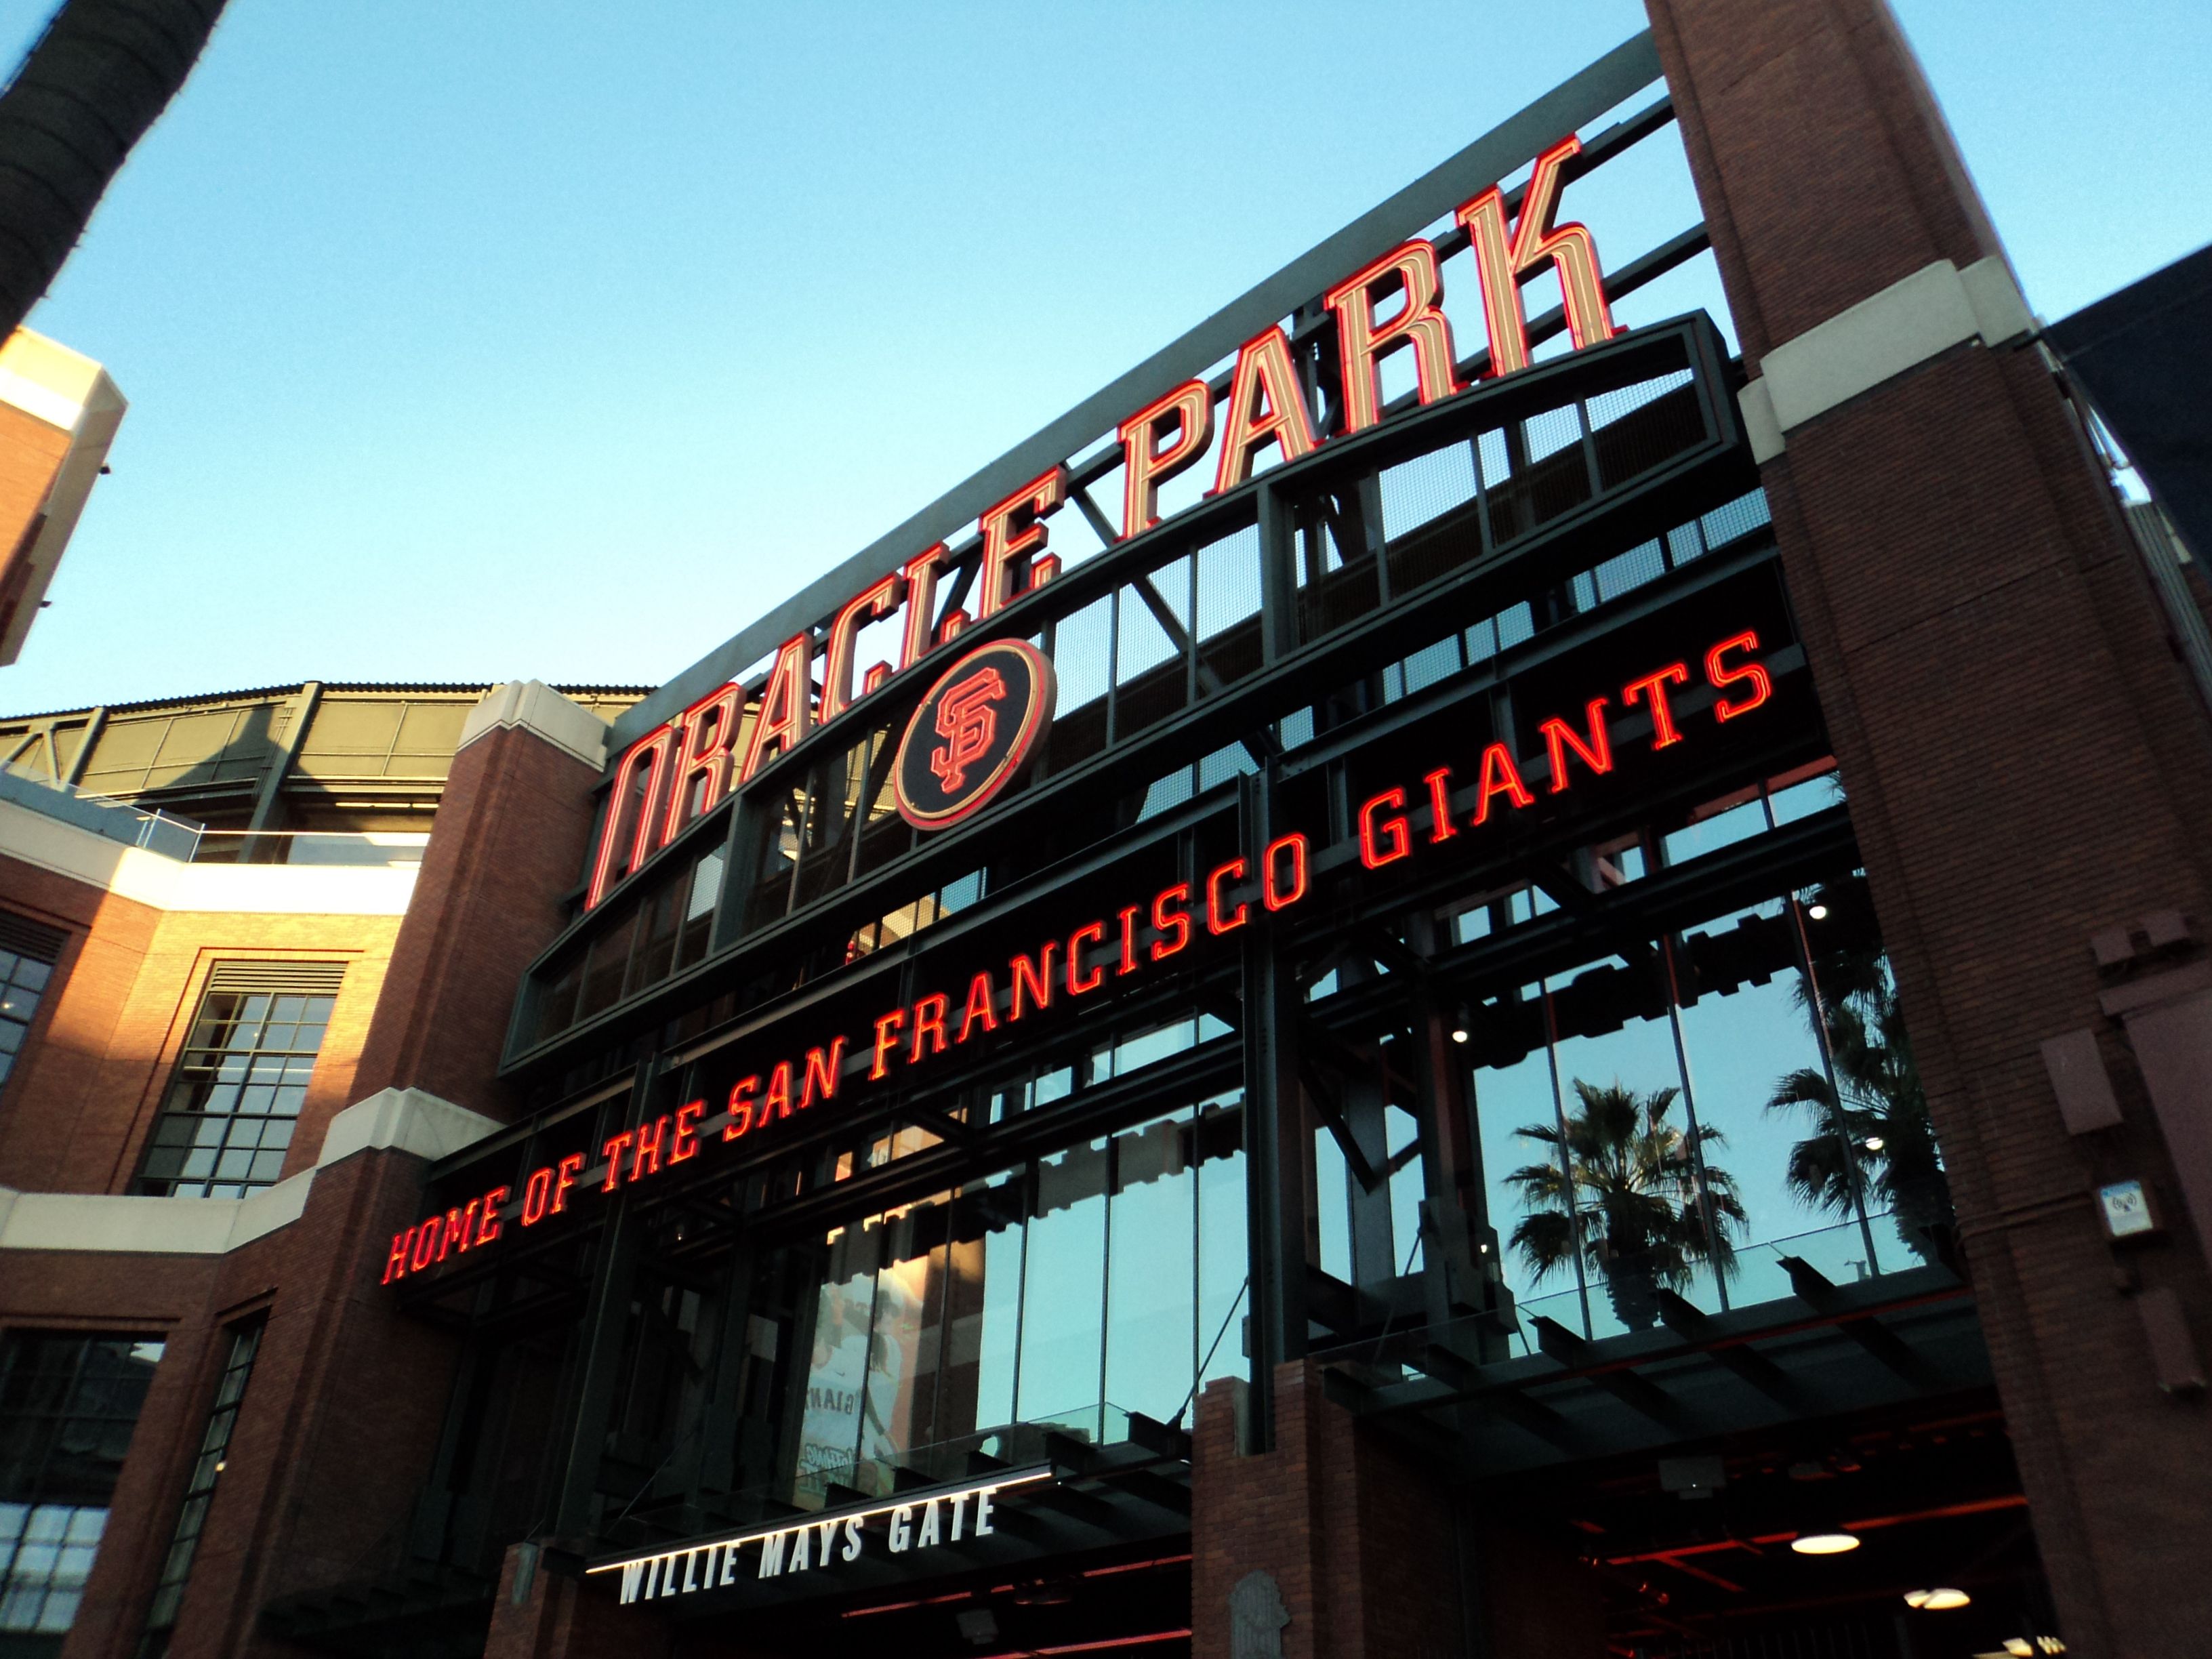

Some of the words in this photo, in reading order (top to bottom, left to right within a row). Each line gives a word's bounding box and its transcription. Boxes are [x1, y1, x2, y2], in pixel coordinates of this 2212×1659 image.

[585, 466, 1067, 911] ORACLE
[1115, 131, 1629, 542] PARK
[380, 1185, 511, 1286] HOME
[520, 1151, 586, 1227] OF
[600, 1099, 708, 1193] THE
[722, 1035, 848, 1143] SAN
[867, 831, 1311, 1081] FRANCISCO
[1357, 626, 1774, 870] GIANTS
[619, 1540, 741, 1605] WILLIE
[758, 1516, 863, 1579] MAYS
[888, 1489, 997, 1553] GATE
